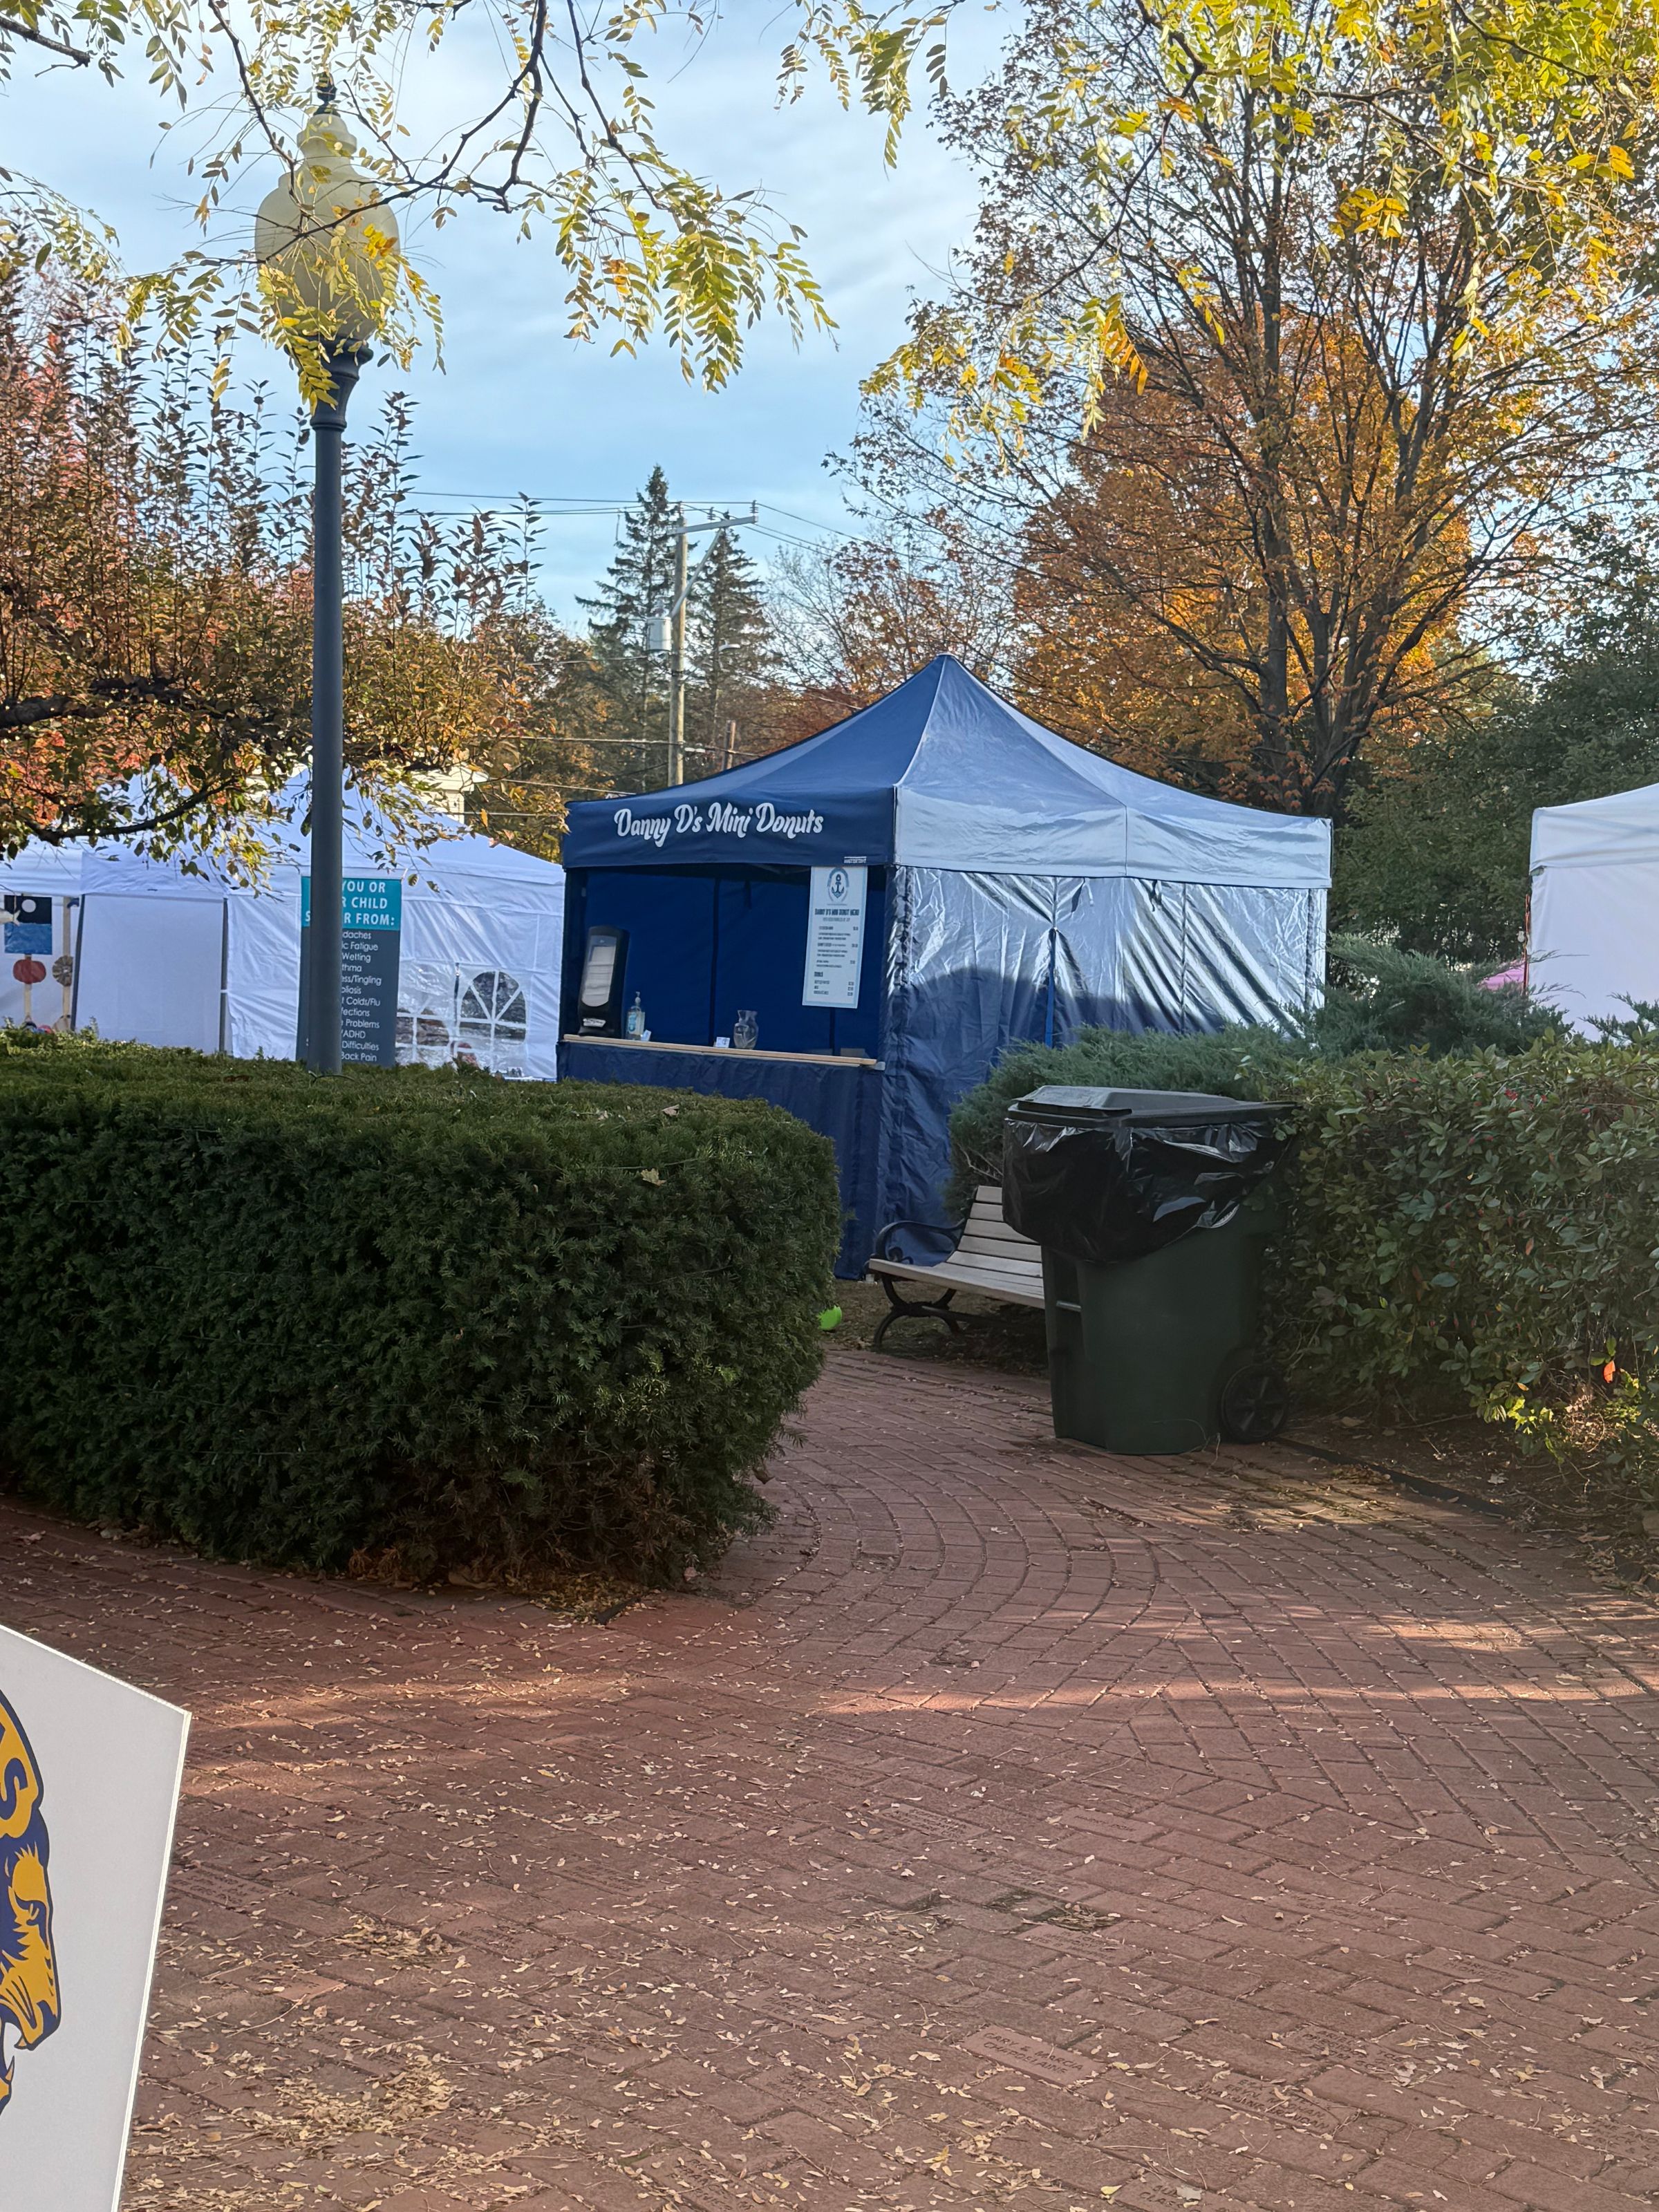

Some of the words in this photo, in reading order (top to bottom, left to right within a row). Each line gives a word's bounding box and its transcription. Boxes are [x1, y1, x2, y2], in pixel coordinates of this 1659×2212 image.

[614, 808, 671, 847] Danny
[674, 804, 702, 833] D's
[706, 802, 753, 838] Mini
[756, 803, 823, 838] Donuts
[369, 882, 385, 892] OR
[351, 897, 387, 909] CHILD
[356, 912, 395, 926] FROM:
[342, 930, 371, 939] daches
[350, 941, 378, 952] Fatigue
[342, 953, 371, 963] Wetting
[342, 964, 362, 972] thma
[346, 996, 380, 1006] Colds/Flu
[346, 1018, 380, 1029] Problems
[360, 1052, 377, 1062] Pain
[984, 2032, 1018, 2046] GARY
[1035, 2050, 1084, 2070] MARCIA
